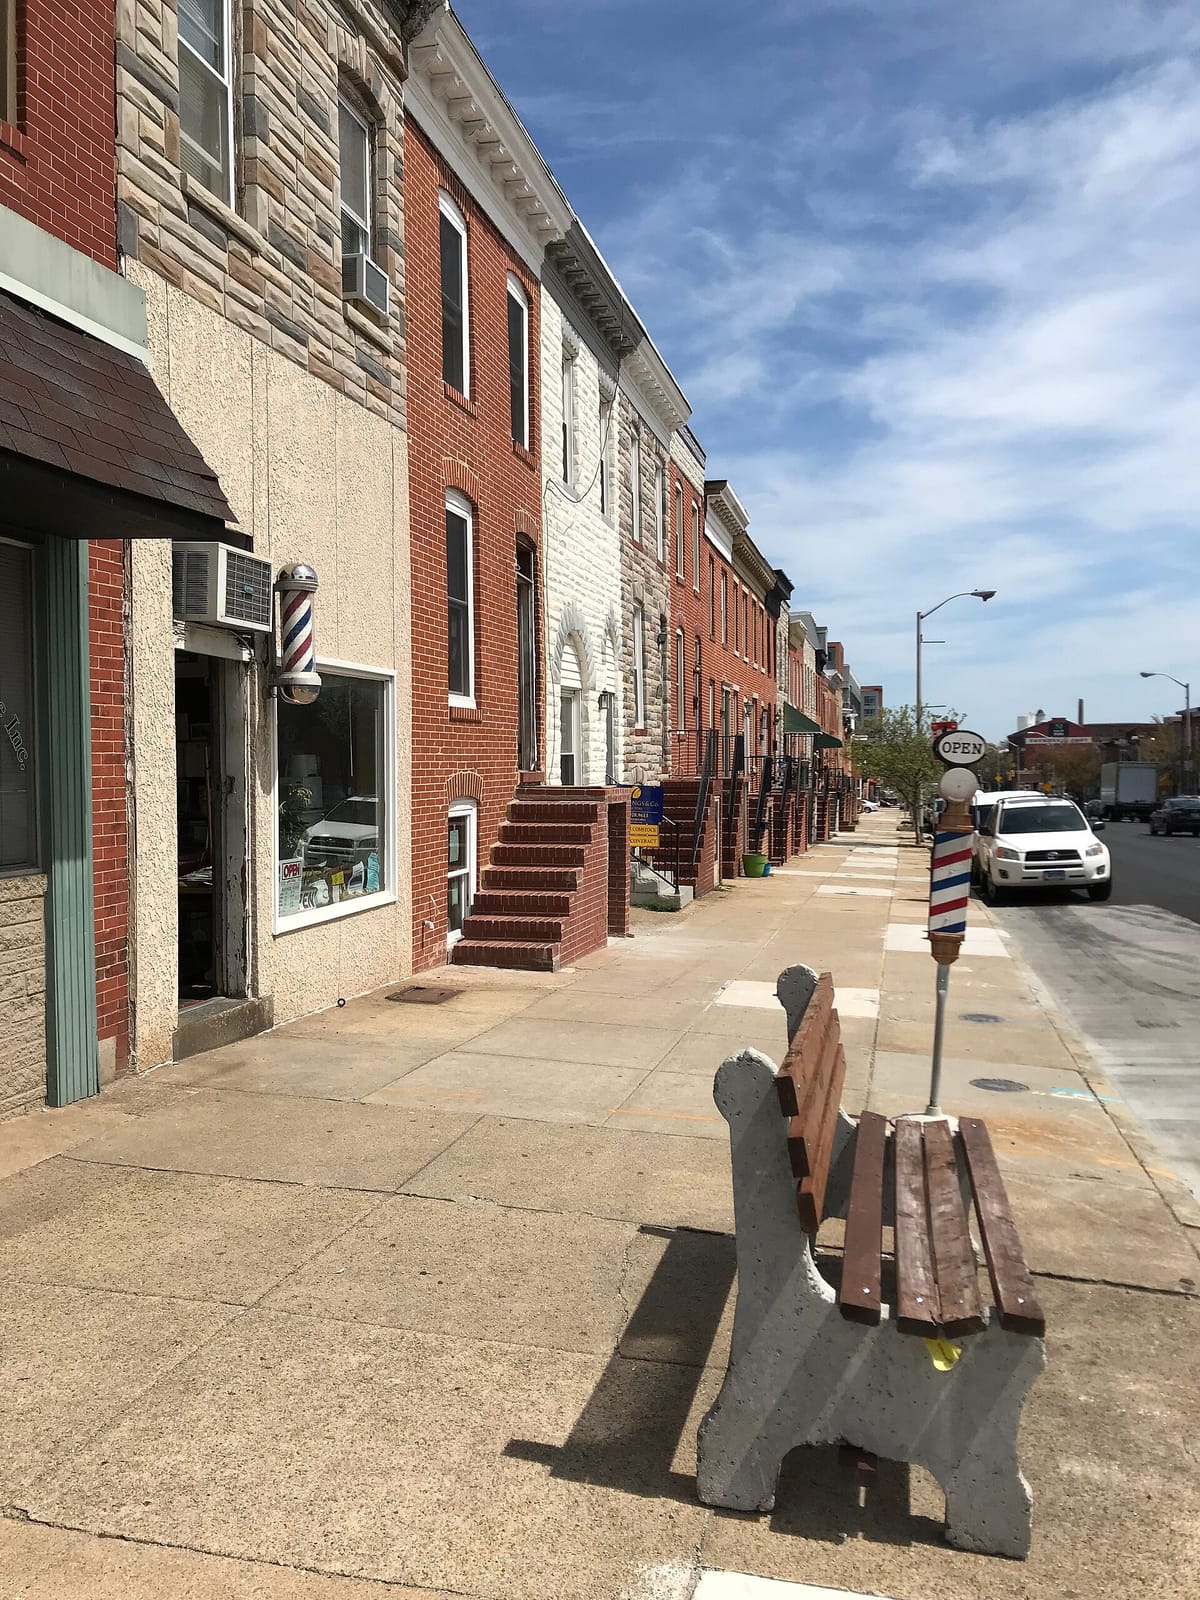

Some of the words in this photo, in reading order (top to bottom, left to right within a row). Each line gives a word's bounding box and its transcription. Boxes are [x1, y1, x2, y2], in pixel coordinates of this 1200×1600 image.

[4, 713, 28, 770] Inc.
[942, 741, 983, 755] OPEN
[283, 863, 300, 878] OPEN
